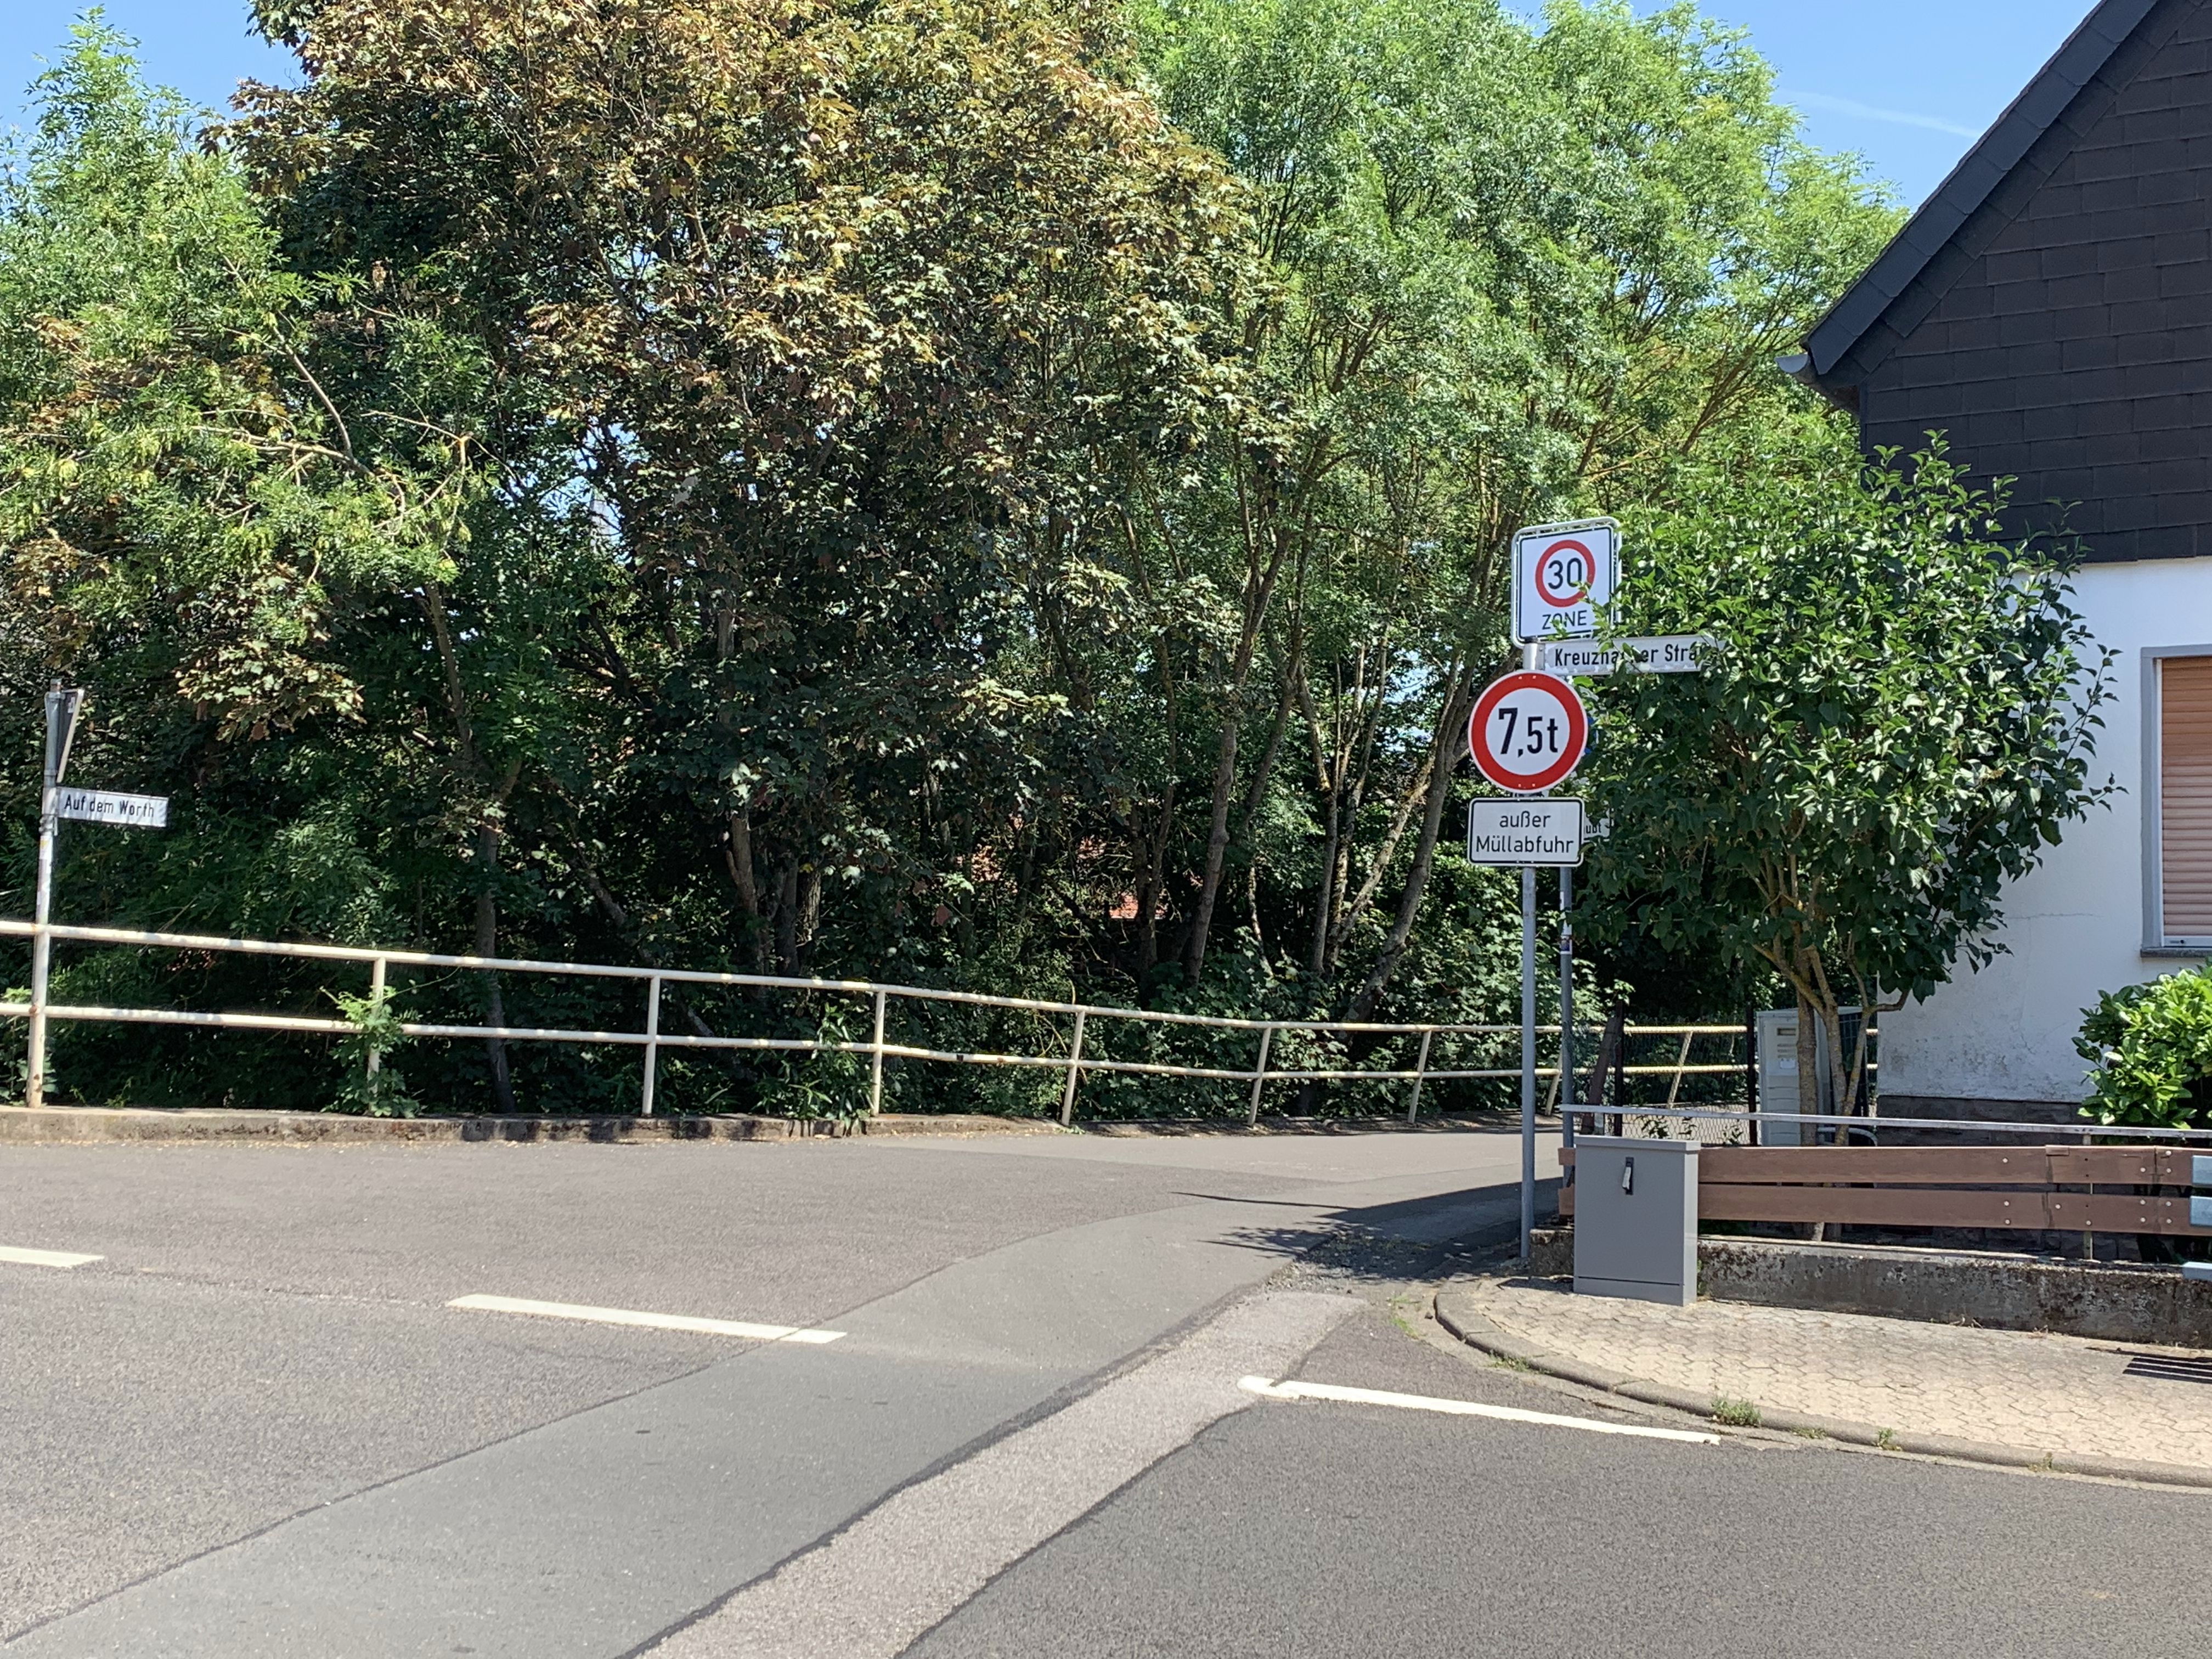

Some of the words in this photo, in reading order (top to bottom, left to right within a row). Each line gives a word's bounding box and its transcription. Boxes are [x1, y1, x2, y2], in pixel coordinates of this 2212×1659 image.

[1548, 557, 1582, 590] 30
[1542, 610, 1587, 630] ZONE
[1498, 707, 1558, 758] 7,5t
[64, 794, 86, 811] Auf
[89, 798, 114, 814] dem
[1499, 810, 1551, 828] außer
[1476, 835, 1574, 853] Müllabfuhr
